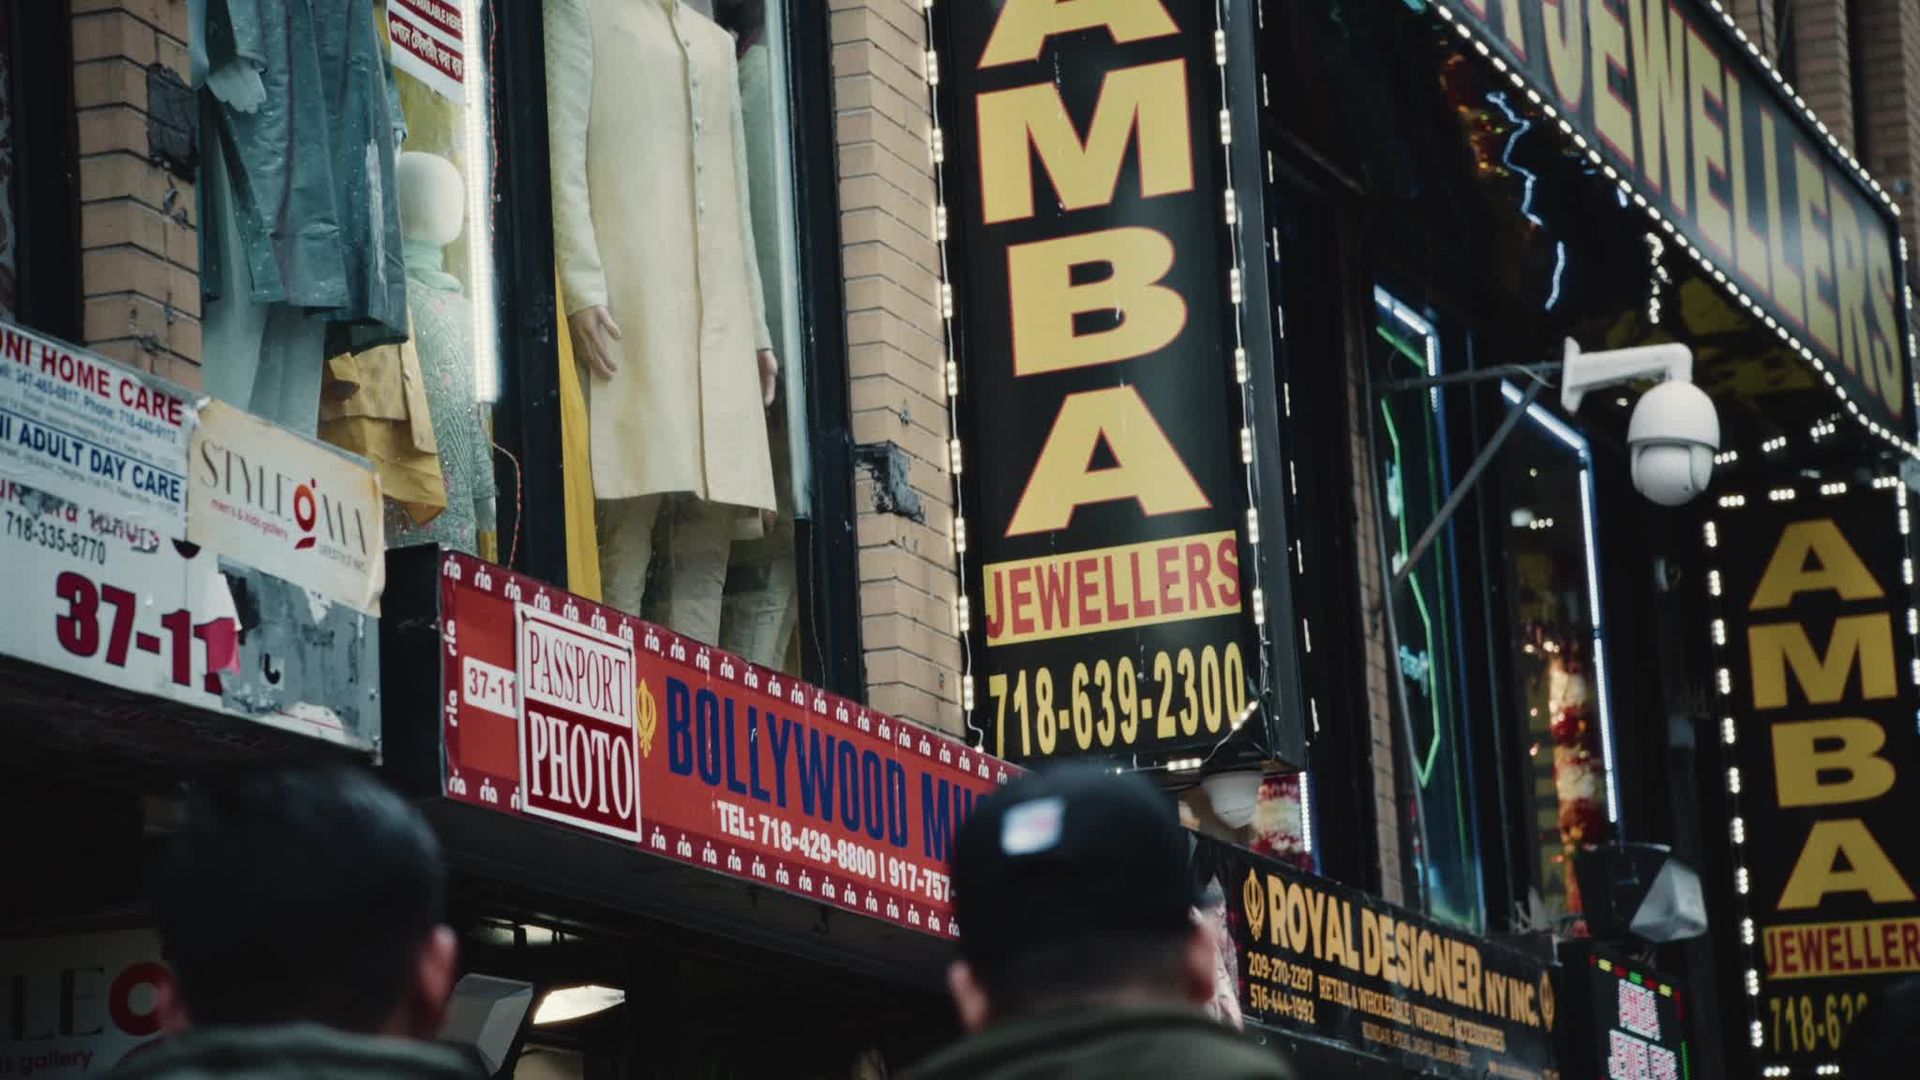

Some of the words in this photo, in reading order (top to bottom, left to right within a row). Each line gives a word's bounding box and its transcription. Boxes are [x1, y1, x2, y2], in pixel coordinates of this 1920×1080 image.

[0, 328, 31, 366] NI
[41, 346, 110, 398] HOME
[120, 378, 183, 427] CARE
[19, 423, 83, 465] ADULT
[90, 449, 125, 482] DAY
[133, 465, 180, 503] CARE
[6, 510, 106, 565] 718-335-8770
[986, 538, 1240, 639] JEWELLERS
[56, 571, 228, 695] 37-11
[444, 555, 461, 580] ria
[475, 565, 492, 591] ria
[505, 576, 521, 600] ria
[534, 586, 550, 611] ria
[563, 598, 579, 622] ria
[591, 608, 607, 632] ria
[619, 618, 634, 641] ria
[645, 628, 660, 652] ria
[671, 638, 685, 661] ria
[696, 648, 710, 671] ria
[720, 656, 734, 679] ria
[745, 666, 758, 689] ria
[768, 674, 782, 697] ria
[791, 683, 804, 705] ria
[814, 692, 827, 714] ria
[836, 701, 849, 723] ria
[858, 709, 870, 732] ria
[879, 717, 891, 740] ria
[899, 727, 911, 749] ria
[919, 735, 931, 756] ria
[939, 743, 951, 764] ria
[959, 751, 971, 772] ria
[978, 759, 990, 779] ria
[529, 631, 627, 717] PASSPORT
[469, 667, 516, 708] 37-11
[989, 642, 1246, 759] 718-639-2300
[1747, 518, 1918, 910] AMBA
[529, 712, 633, 819] PHOTO
[666, 676, 908, 848] BOLLYWOOD
[449, 769, 466, 795] ria
[480, 778, 497, 803] ria
[510, 787, 521, 811] ri
[651, 827, 666, 850] ria
[677, 834, 692, 857] ria
[703, 841, 717, 864] ria
[728, 848, 741, 871] ria
[752, 856, 765, 878] ria
[776, 863, 789, 885] ria
[799, 870, 812, 891] ria
[822, 876, 835, 898] ria
[844, 884, 856, 905] ria
[866, 891, 878, 912] ria
[887, 898, 899, 918] ria
[908, 904, 920, 925] ria
[928, 910, 940, 931] ria
[718, 800, 755, 840] TEL:
[759, 814, 876, 879] 718-429-8800
[1267, 874, 1360, 971] ROYAL
[1361, 908, 1482, 1012] DESIGNER
[1485, 970, 1507, 1018] NY
[1509, 978, 1540, 1028] INC.
[1769, 993, 1868, 1053] 718-6
